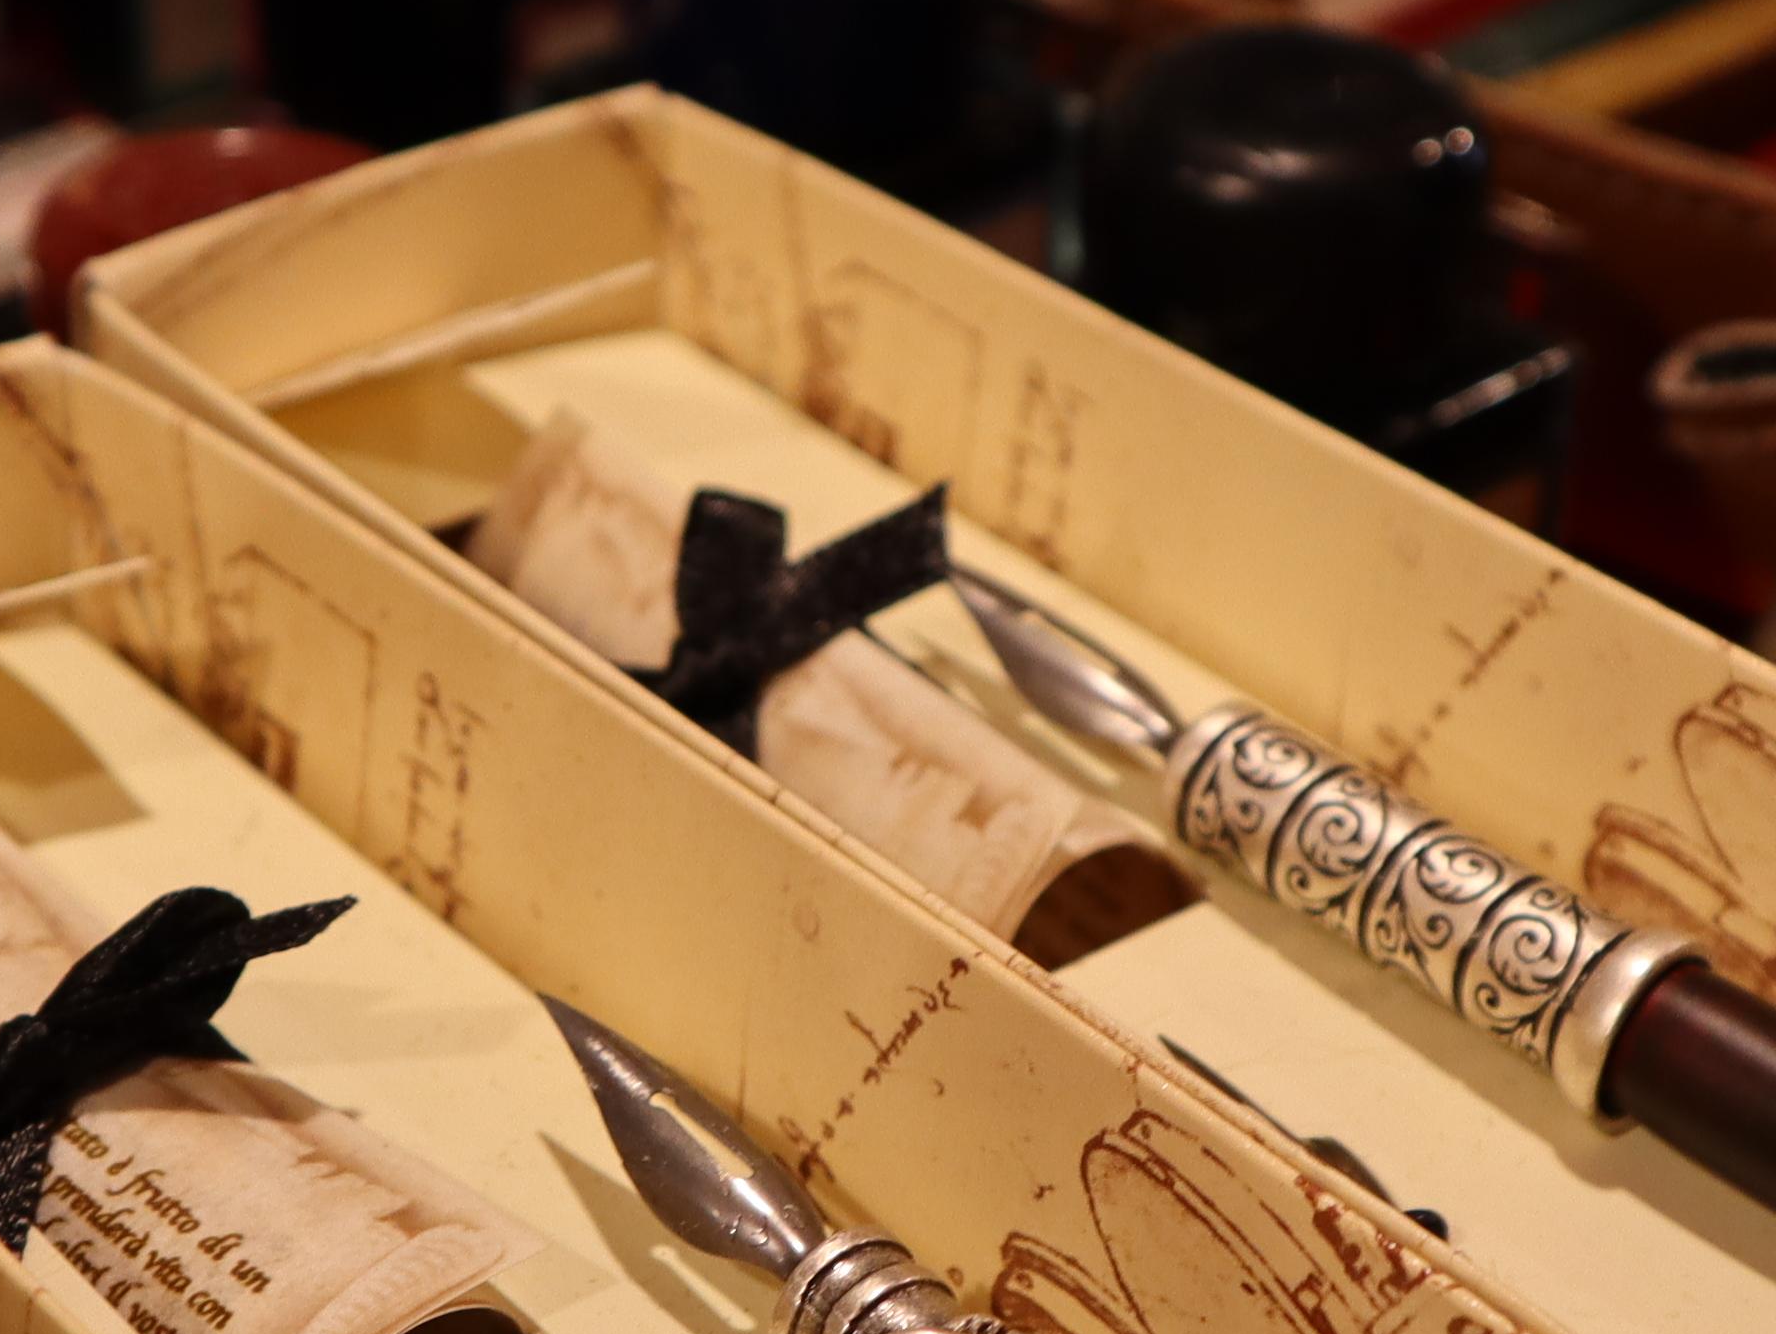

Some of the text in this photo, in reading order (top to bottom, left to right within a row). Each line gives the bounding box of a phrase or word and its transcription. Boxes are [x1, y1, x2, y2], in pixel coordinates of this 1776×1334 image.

[41, 1173, 235, 1332] prenderà vita con
[104, 1168, 202, 1235] frutto
[196, 1231, 244, 1262] di
[229, 1258, 273, 1295] un
